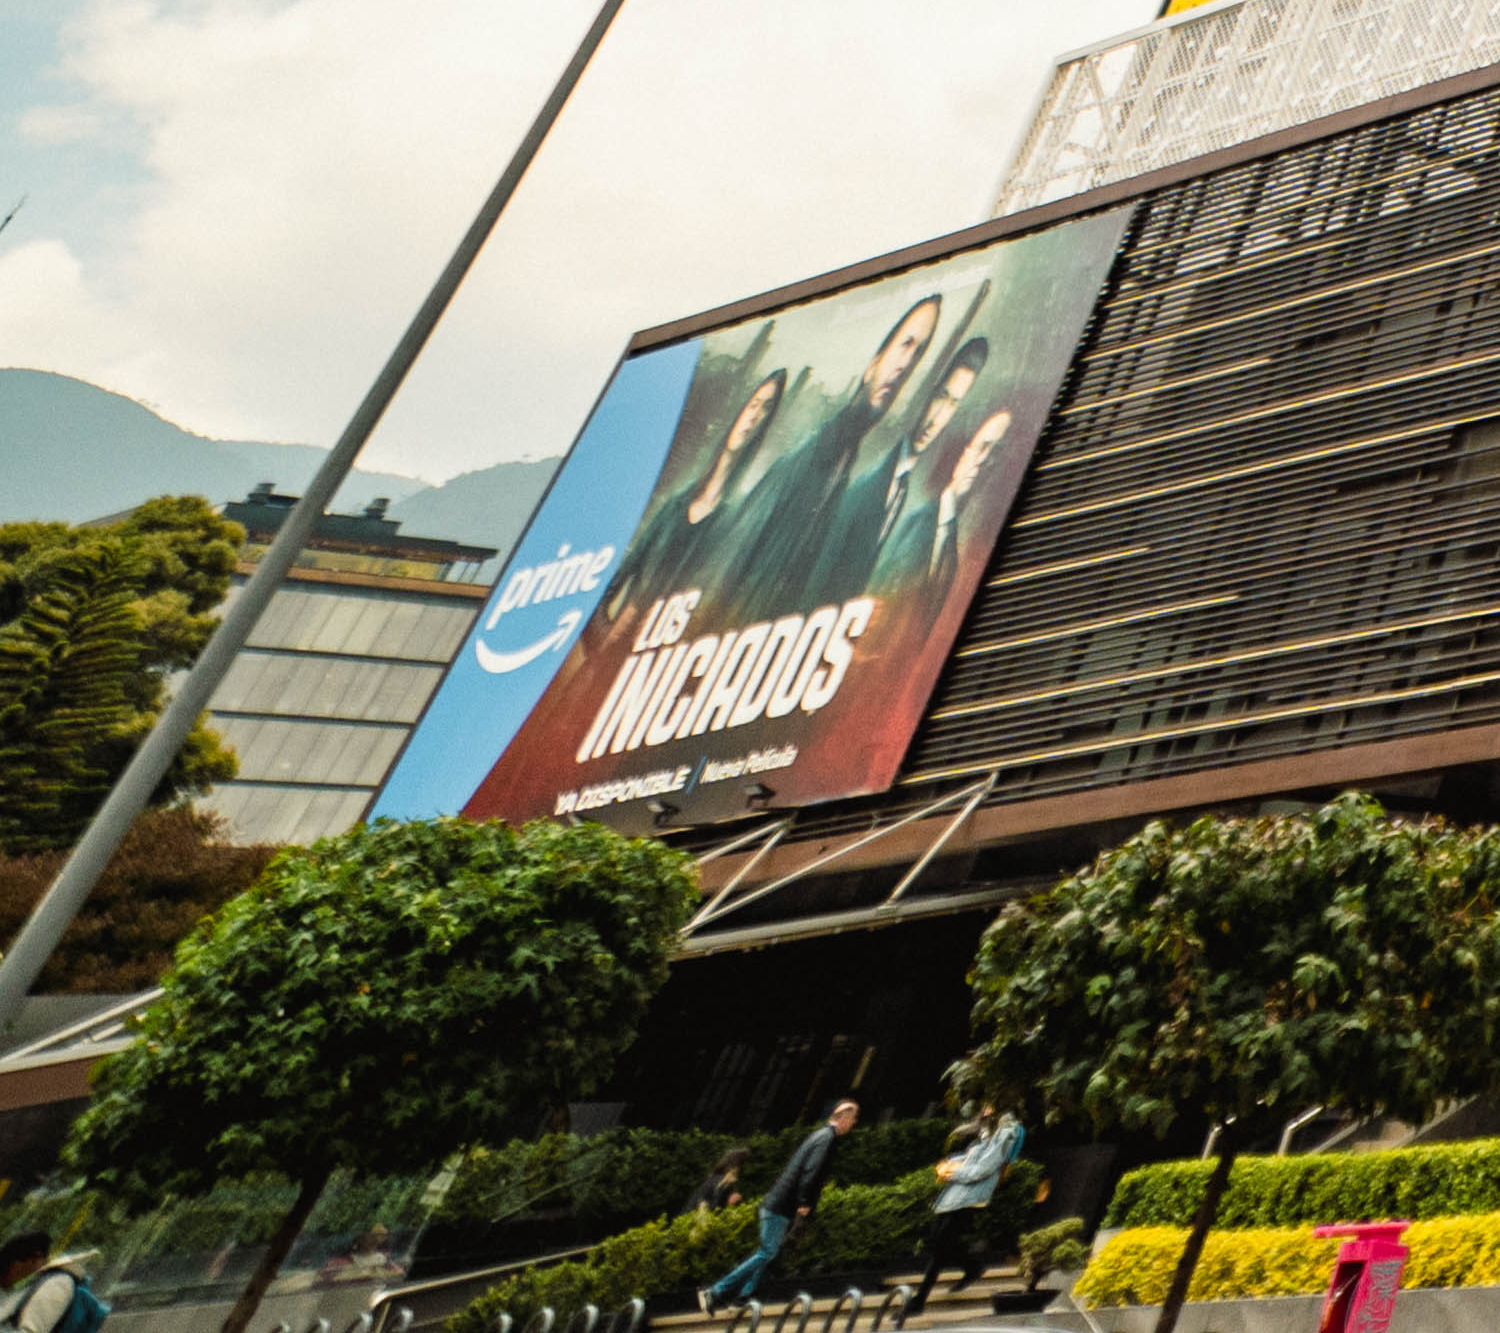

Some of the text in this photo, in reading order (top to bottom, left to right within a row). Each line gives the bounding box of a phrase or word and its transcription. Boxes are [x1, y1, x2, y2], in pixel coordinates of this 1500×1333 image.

[485, 541, 617, 631] prime
[632, 588, 702, 653] LOS
[575, 595, 875, 763] INICIADOS
[574, 765, 693, 812] DISPONIBLE
